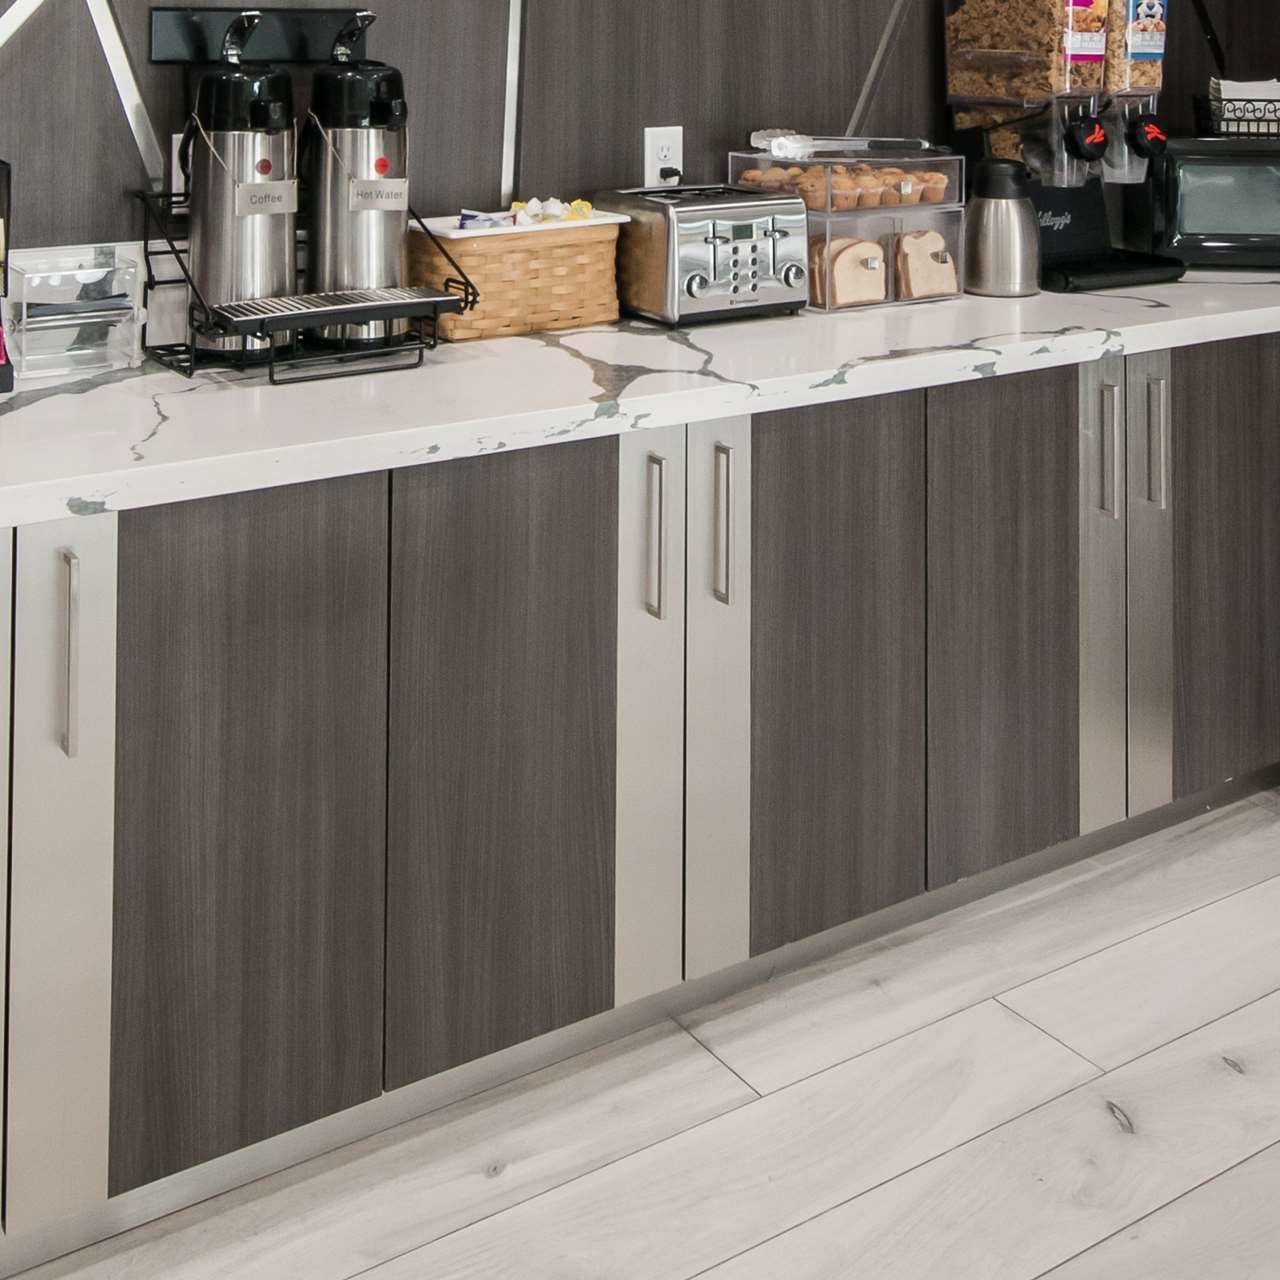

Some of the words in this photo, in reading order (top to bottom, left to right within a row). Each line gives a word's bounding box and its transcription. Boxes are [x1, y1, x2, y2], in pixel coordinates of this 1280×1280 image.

[249, 193, 283, 206] Coffee
[356, 190, 373, 201] Hot
[374, 190, 403, 200] Water
